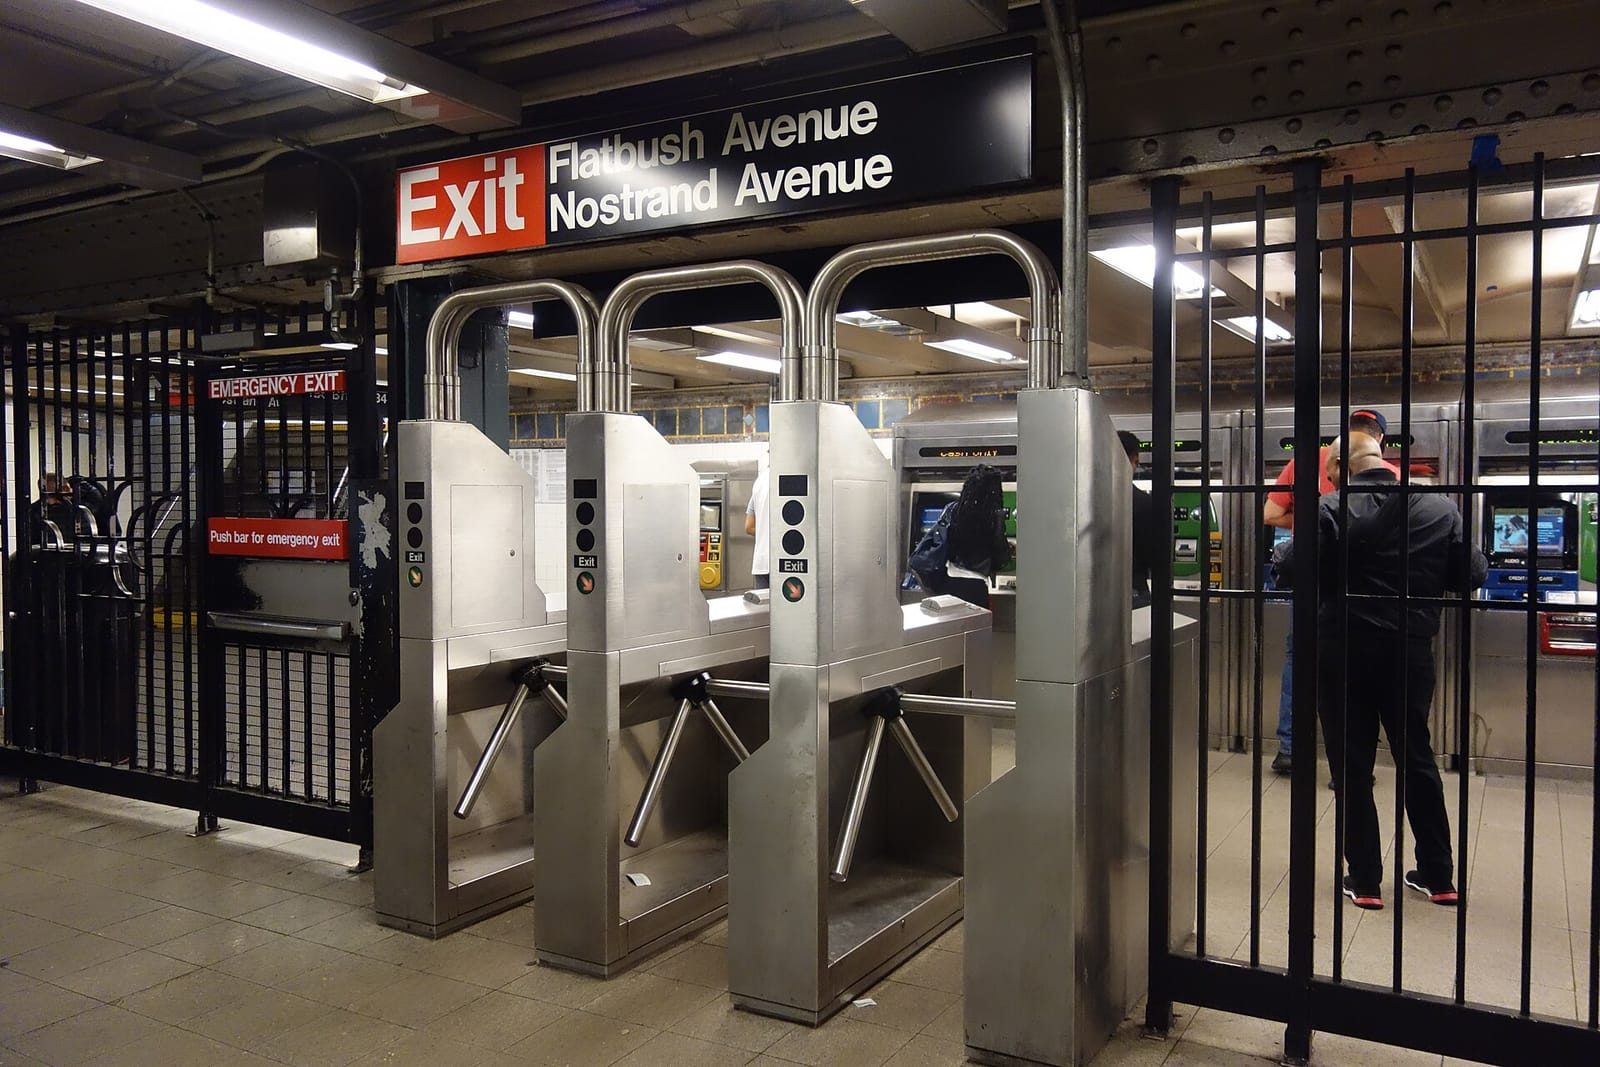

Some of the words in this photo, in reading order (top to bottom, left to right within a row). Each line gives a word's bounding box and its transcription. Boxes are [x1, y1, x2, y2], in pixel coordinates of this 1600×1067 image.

[549, 121, 705, 185] Flatbush
[722, 99, 878, 157] Avenue
[398, 155, 526, 246] Exit
[550, 166, 718, 234] Nostrand
[735, 153, 893, 207] Avenue
[211, 375, 298, 399] EMERGENCY
[304, 372, 339, 393] EXIT
[210, 530, 232, 544] Push
[233, 530, 249, 544] bar
[251, 531, 265, 544] for
[267, 533, 319, 548] emergency
[322, 534, 341, 547] exit
[408, 552, 424, 562] Exit
[578, 556, 595, 568] Exit
[783, 560, 804, 573] Exit
